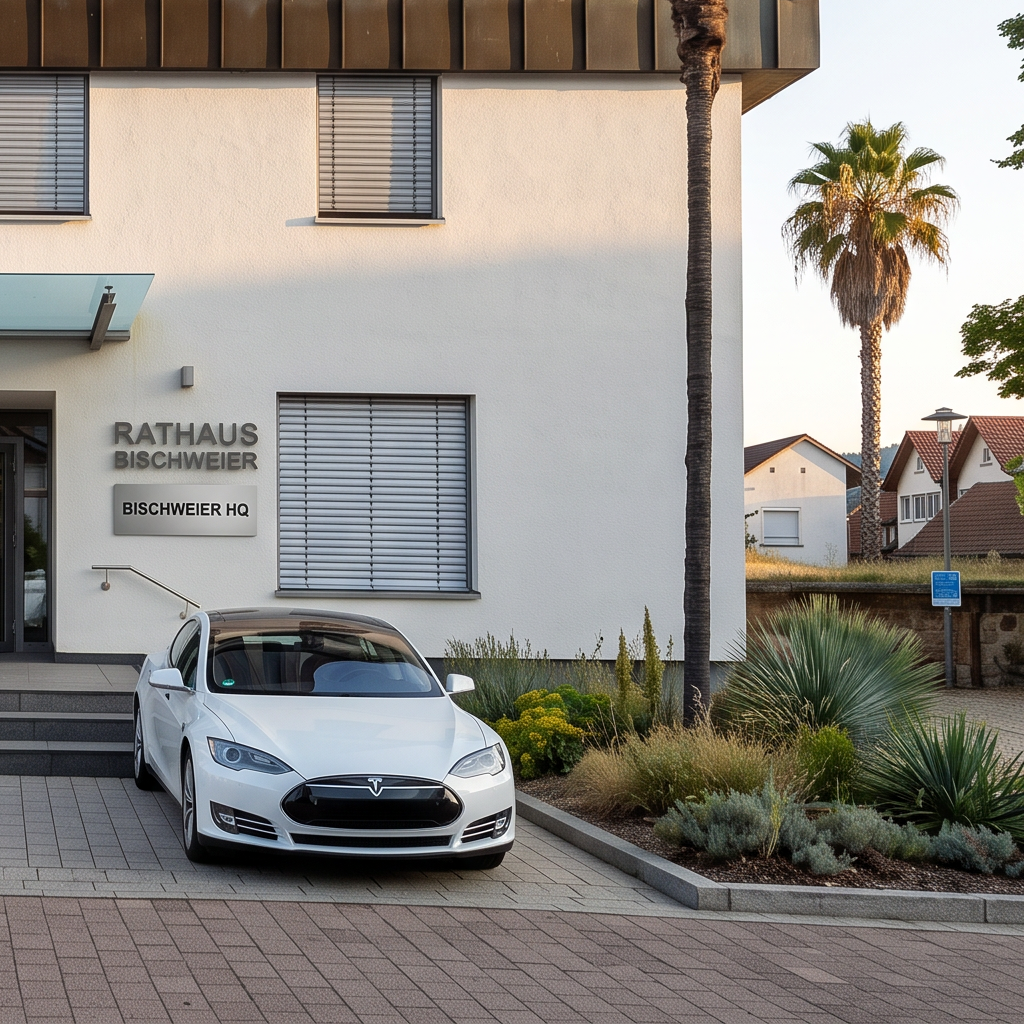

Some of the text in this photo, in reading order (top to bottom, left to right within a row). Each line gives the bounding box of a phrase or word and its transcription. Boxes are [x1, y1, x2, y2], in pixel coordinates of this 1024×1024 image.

[114, 421, 258, 445] RATHAUS
[114, 450, 258, 470] BISCHWEIER
[122, 502, 249, 517] BISCHWEIER HQ
